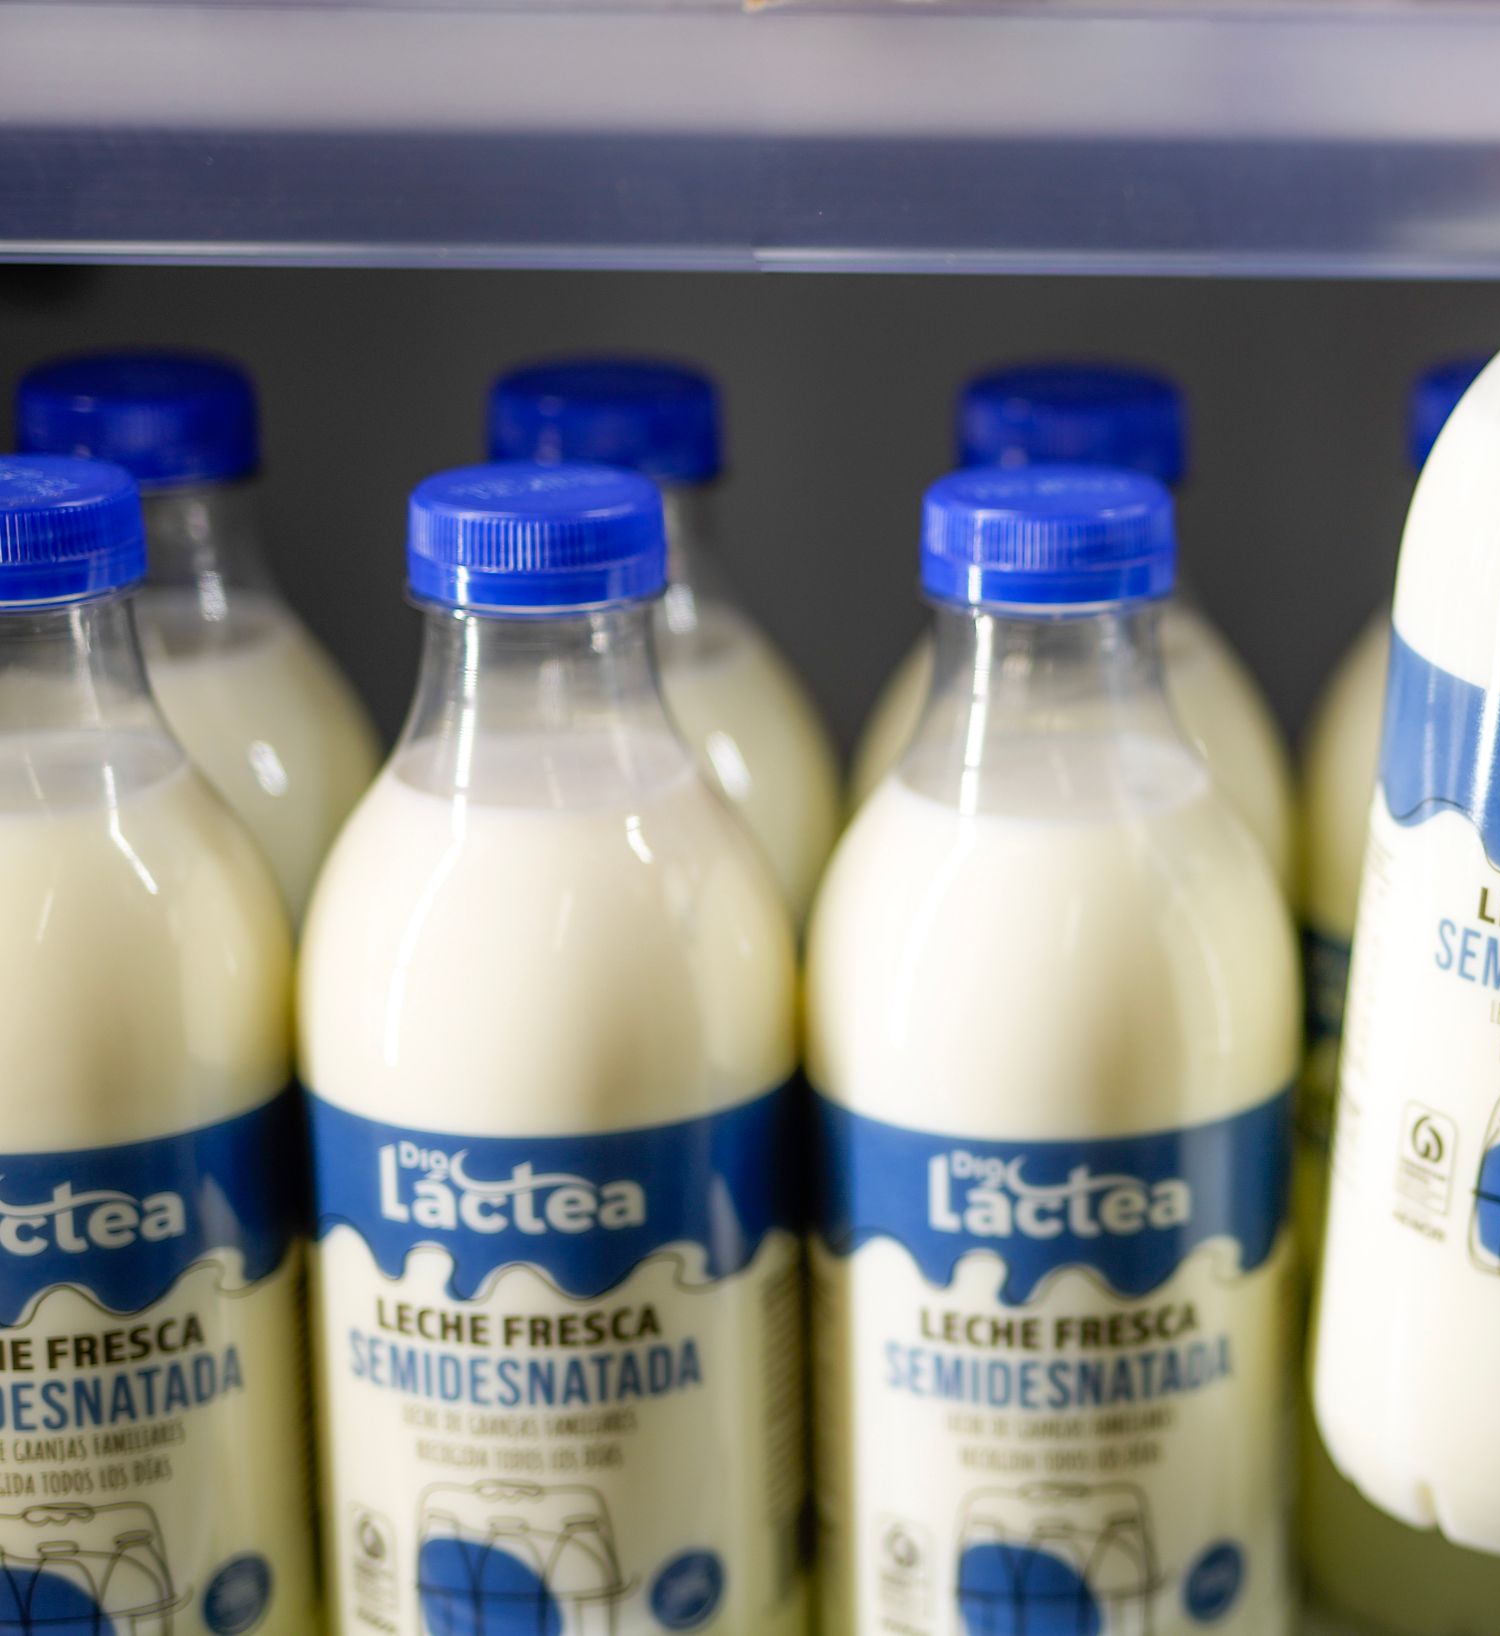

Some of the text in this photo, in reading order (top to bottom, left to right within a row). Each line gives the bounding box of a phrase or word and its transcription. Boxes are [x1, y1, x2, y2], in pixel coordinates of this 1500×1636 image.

[0, 1181, 187, 1256] ctea
[46, 1313, 204, 1370] FRESCA
[377, 1297, 662, 1348] LECHE FRESCA
[921, 1302, 1198, 1350] LECHE FRESCA
[0, 1343, 244, 1432] ESNATADA
[350, 1328, 704, 1407] SEMIDESNATADA
[885, 1334, 1232, 1410] SEMIDESNATADA
